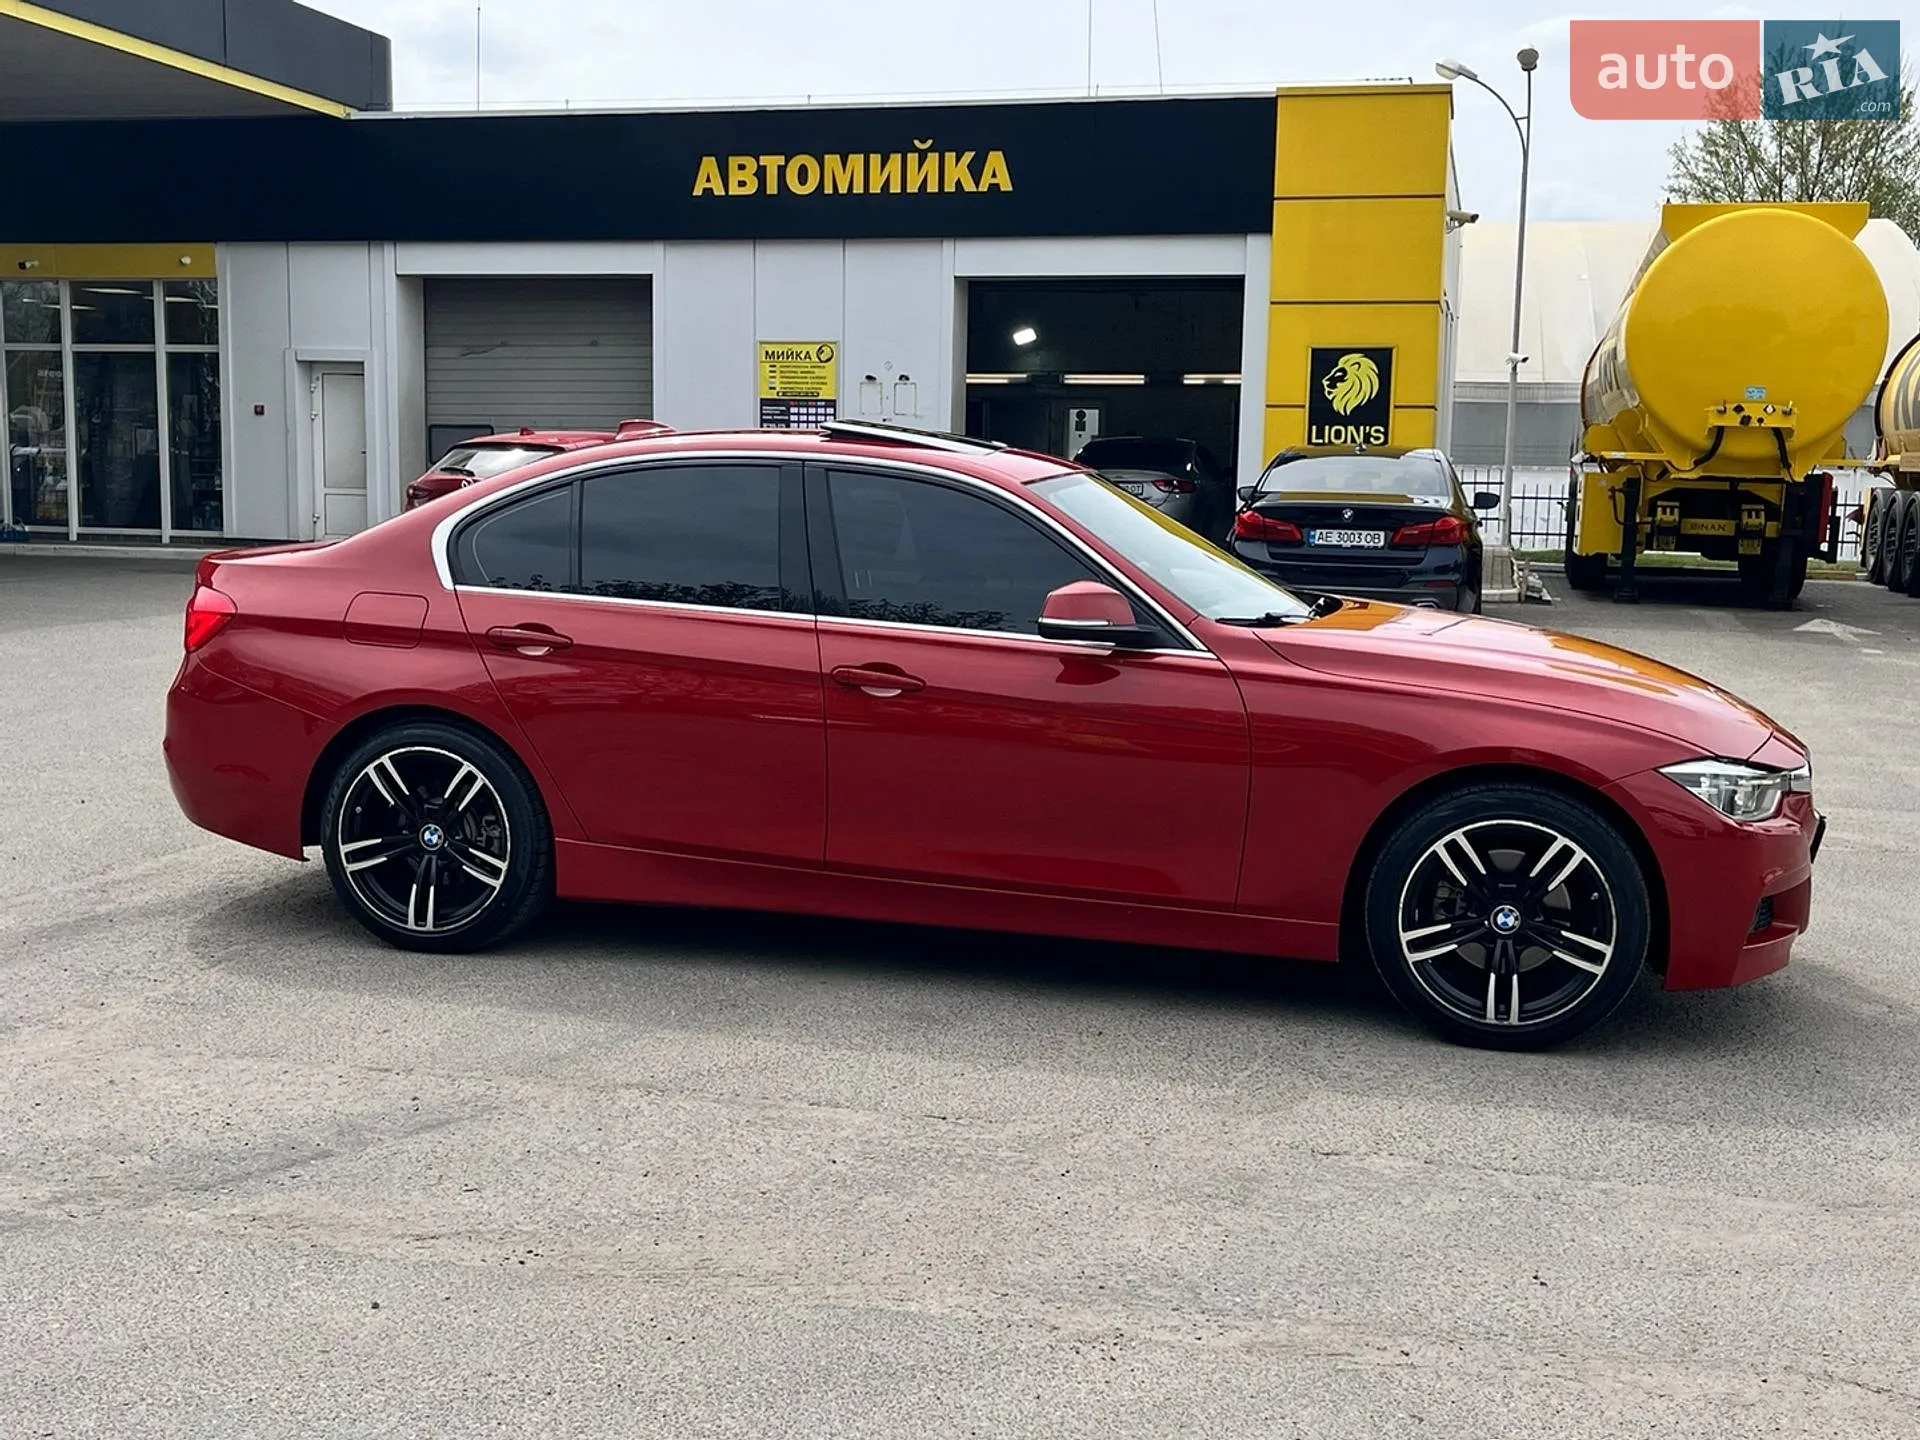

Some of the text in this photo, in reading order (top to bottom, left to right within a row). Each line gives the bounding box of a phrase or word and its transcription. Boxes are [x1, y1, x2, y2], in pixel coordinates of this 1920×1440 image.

[692, 138, 1014, 197] АВТОМИЙКА
[765, 348, 812, 361] МИЙКА
[1311, 425, 1385, 445] LION'S
[1317, 531, 1333, 543] AE
[1336, 531, 1362, 544] 3003
[1365, 533, 1381, 545] OB
